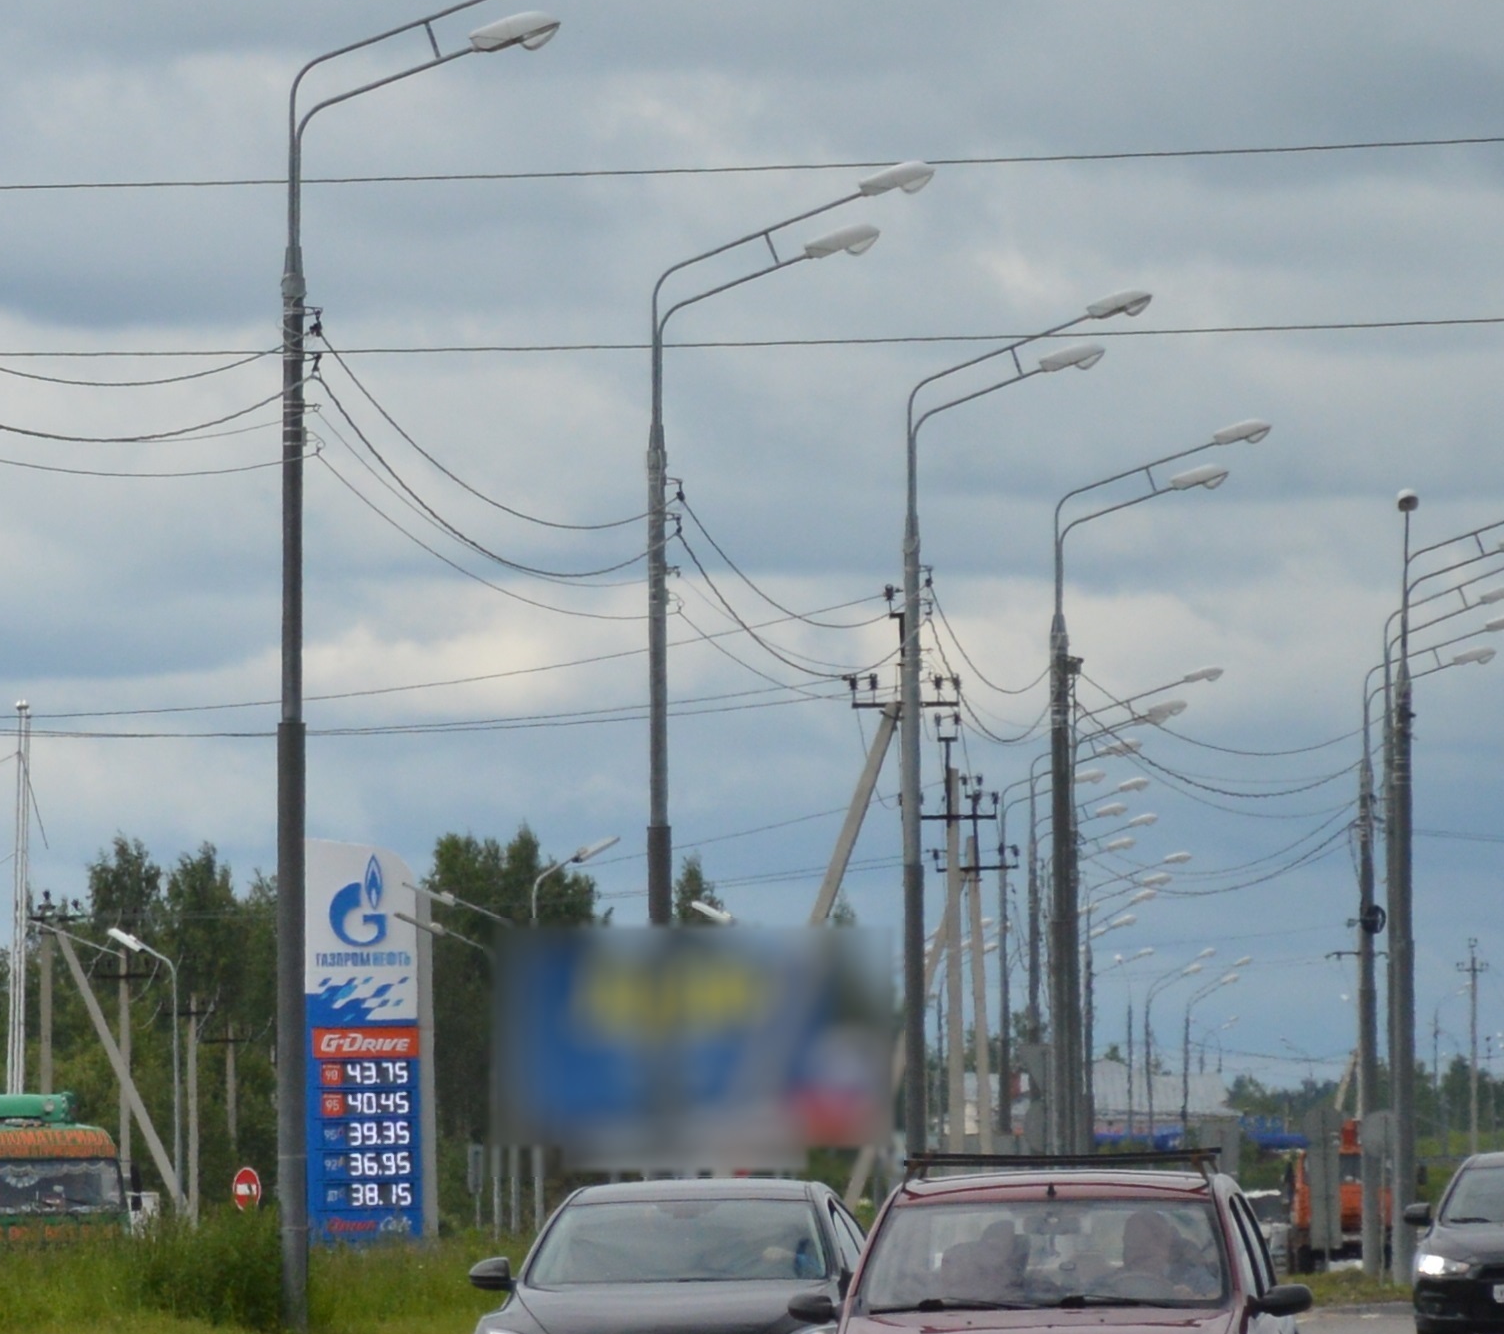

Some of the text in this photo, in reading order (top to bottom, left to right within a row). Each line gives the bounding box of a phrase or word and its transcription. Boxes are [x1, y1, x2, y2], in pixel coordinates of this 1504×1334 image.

[315, 952, 411, 967] ГАЗПРОМНЕФТЬ
[347, 1062, 408, 1084] 43.75
[326, 1092, 409, 1114] 95 40.45
[349, 1121, 410, 1146] 39.35
[324, 1152, 410, 1176] 92 36.95
[352, 1183, 412, 1206] 38.15
